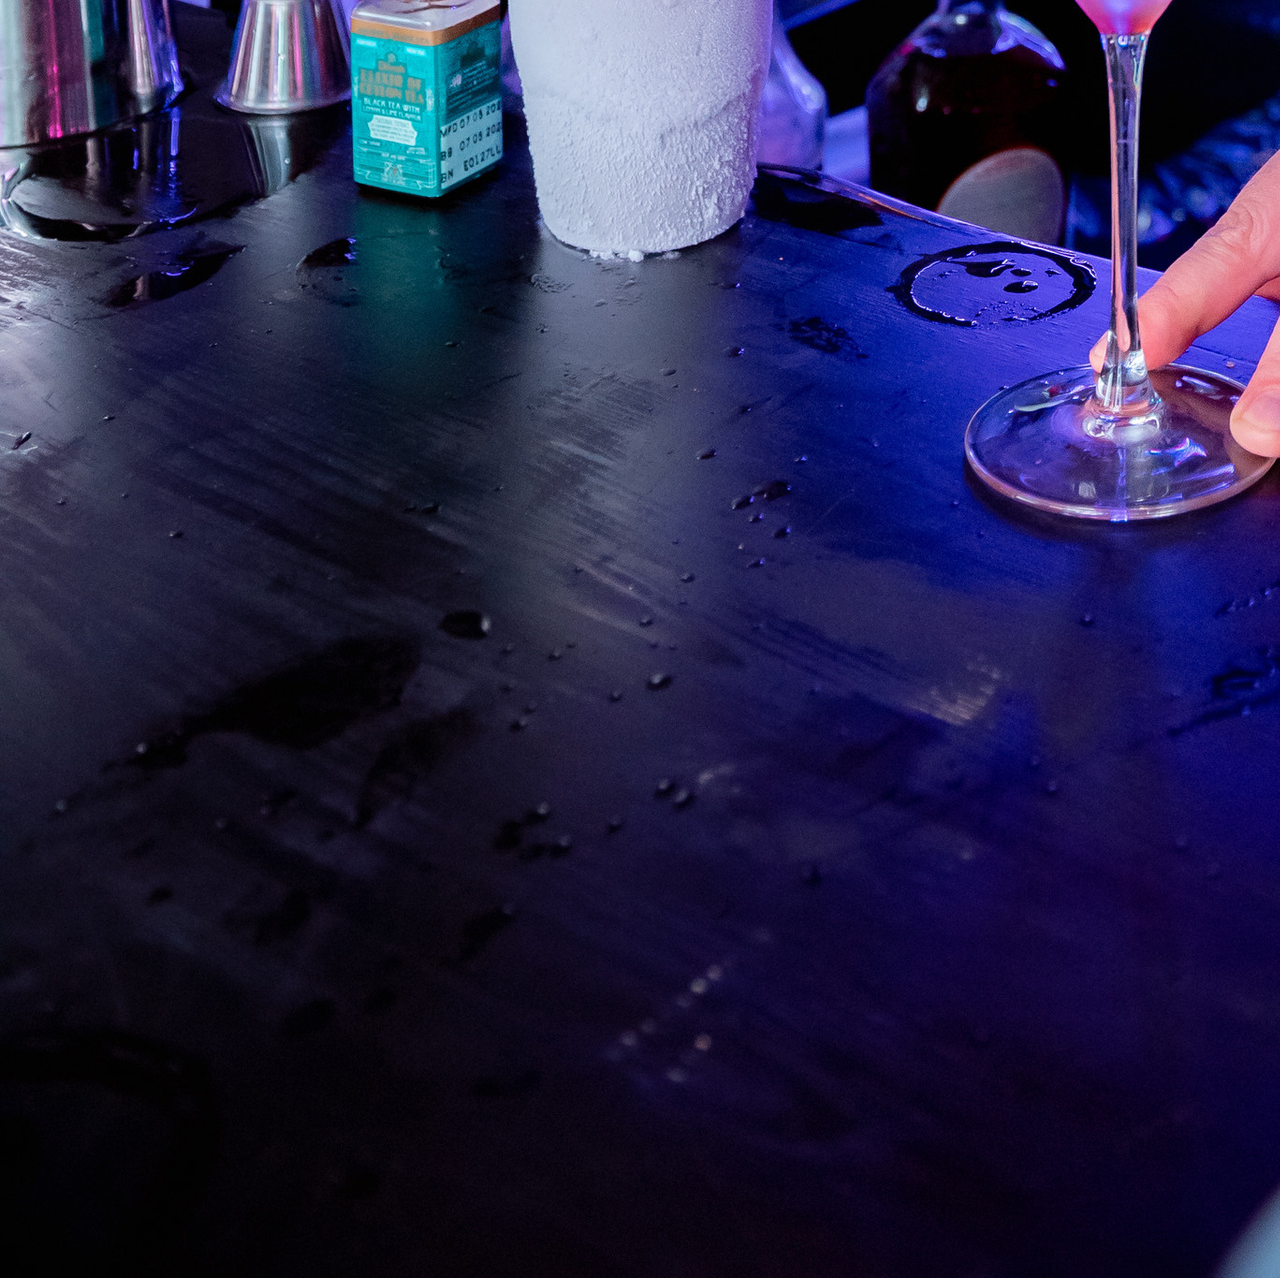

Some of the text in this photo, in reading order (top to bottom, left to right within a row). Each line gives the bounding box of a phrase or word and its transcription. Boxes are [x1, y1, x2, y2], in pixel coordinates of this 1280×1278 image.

[363, 97, 421, 114] BLACK TEA WITH
